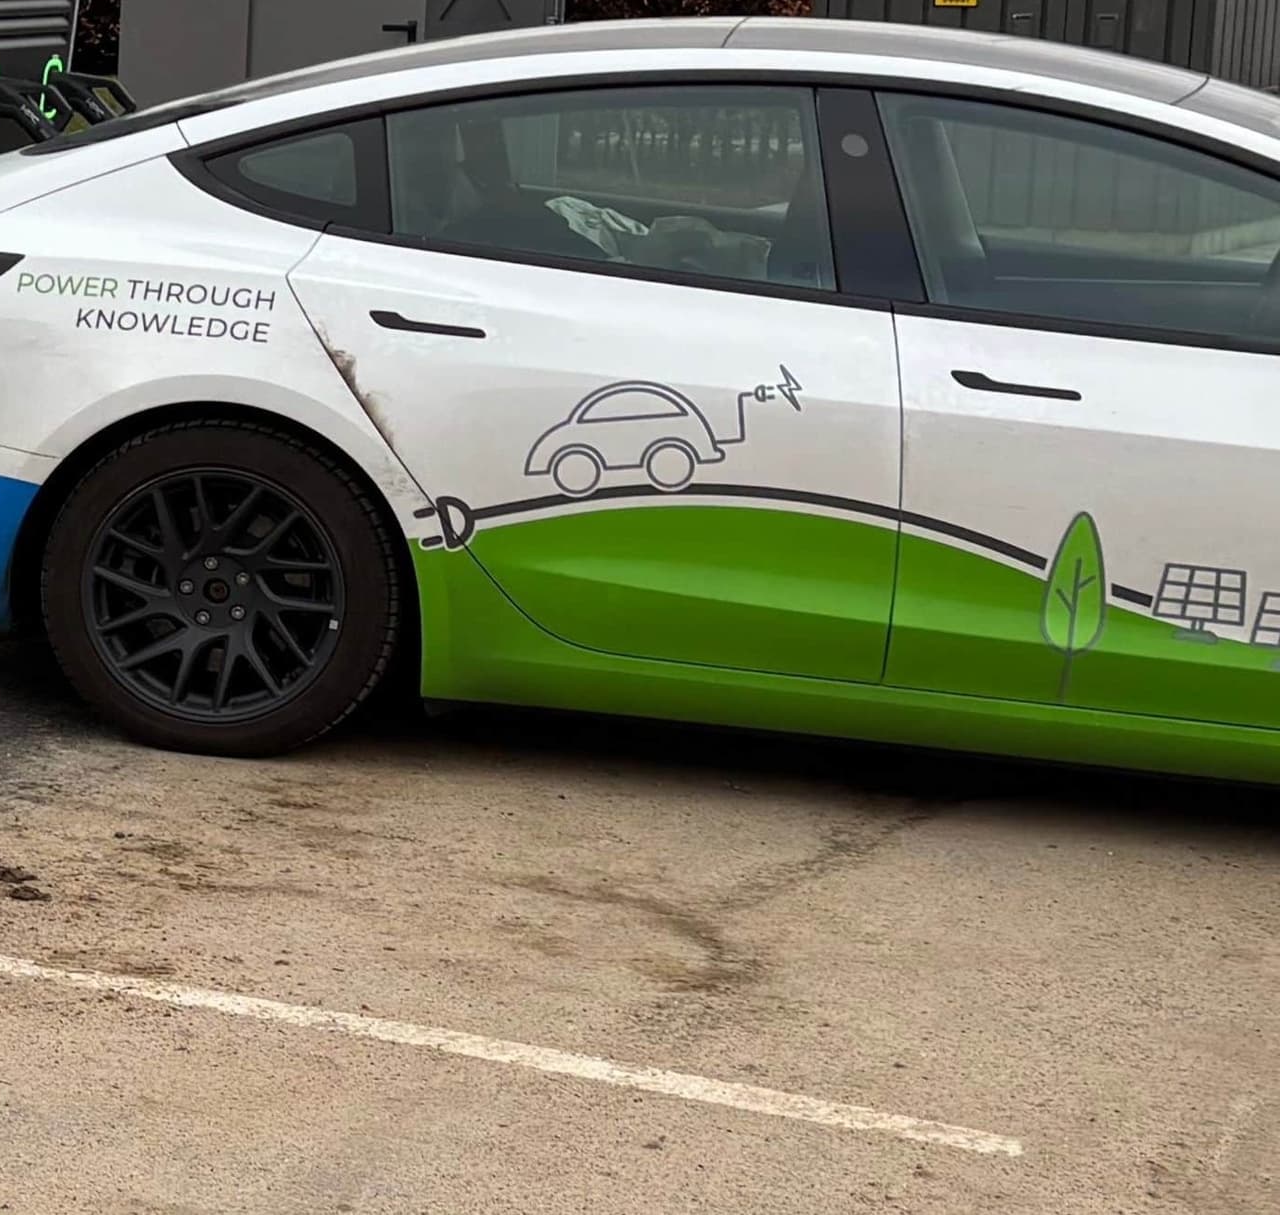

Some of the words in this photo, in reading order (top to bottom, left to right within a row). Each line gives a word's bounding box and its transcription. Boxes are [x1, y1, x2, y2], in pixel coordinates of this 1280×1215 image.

[17, 273, 119, 299] POWER
[127, 279, 276, 311] THROUGH
[75, 308, 271, 344] KNOWLEDGE
